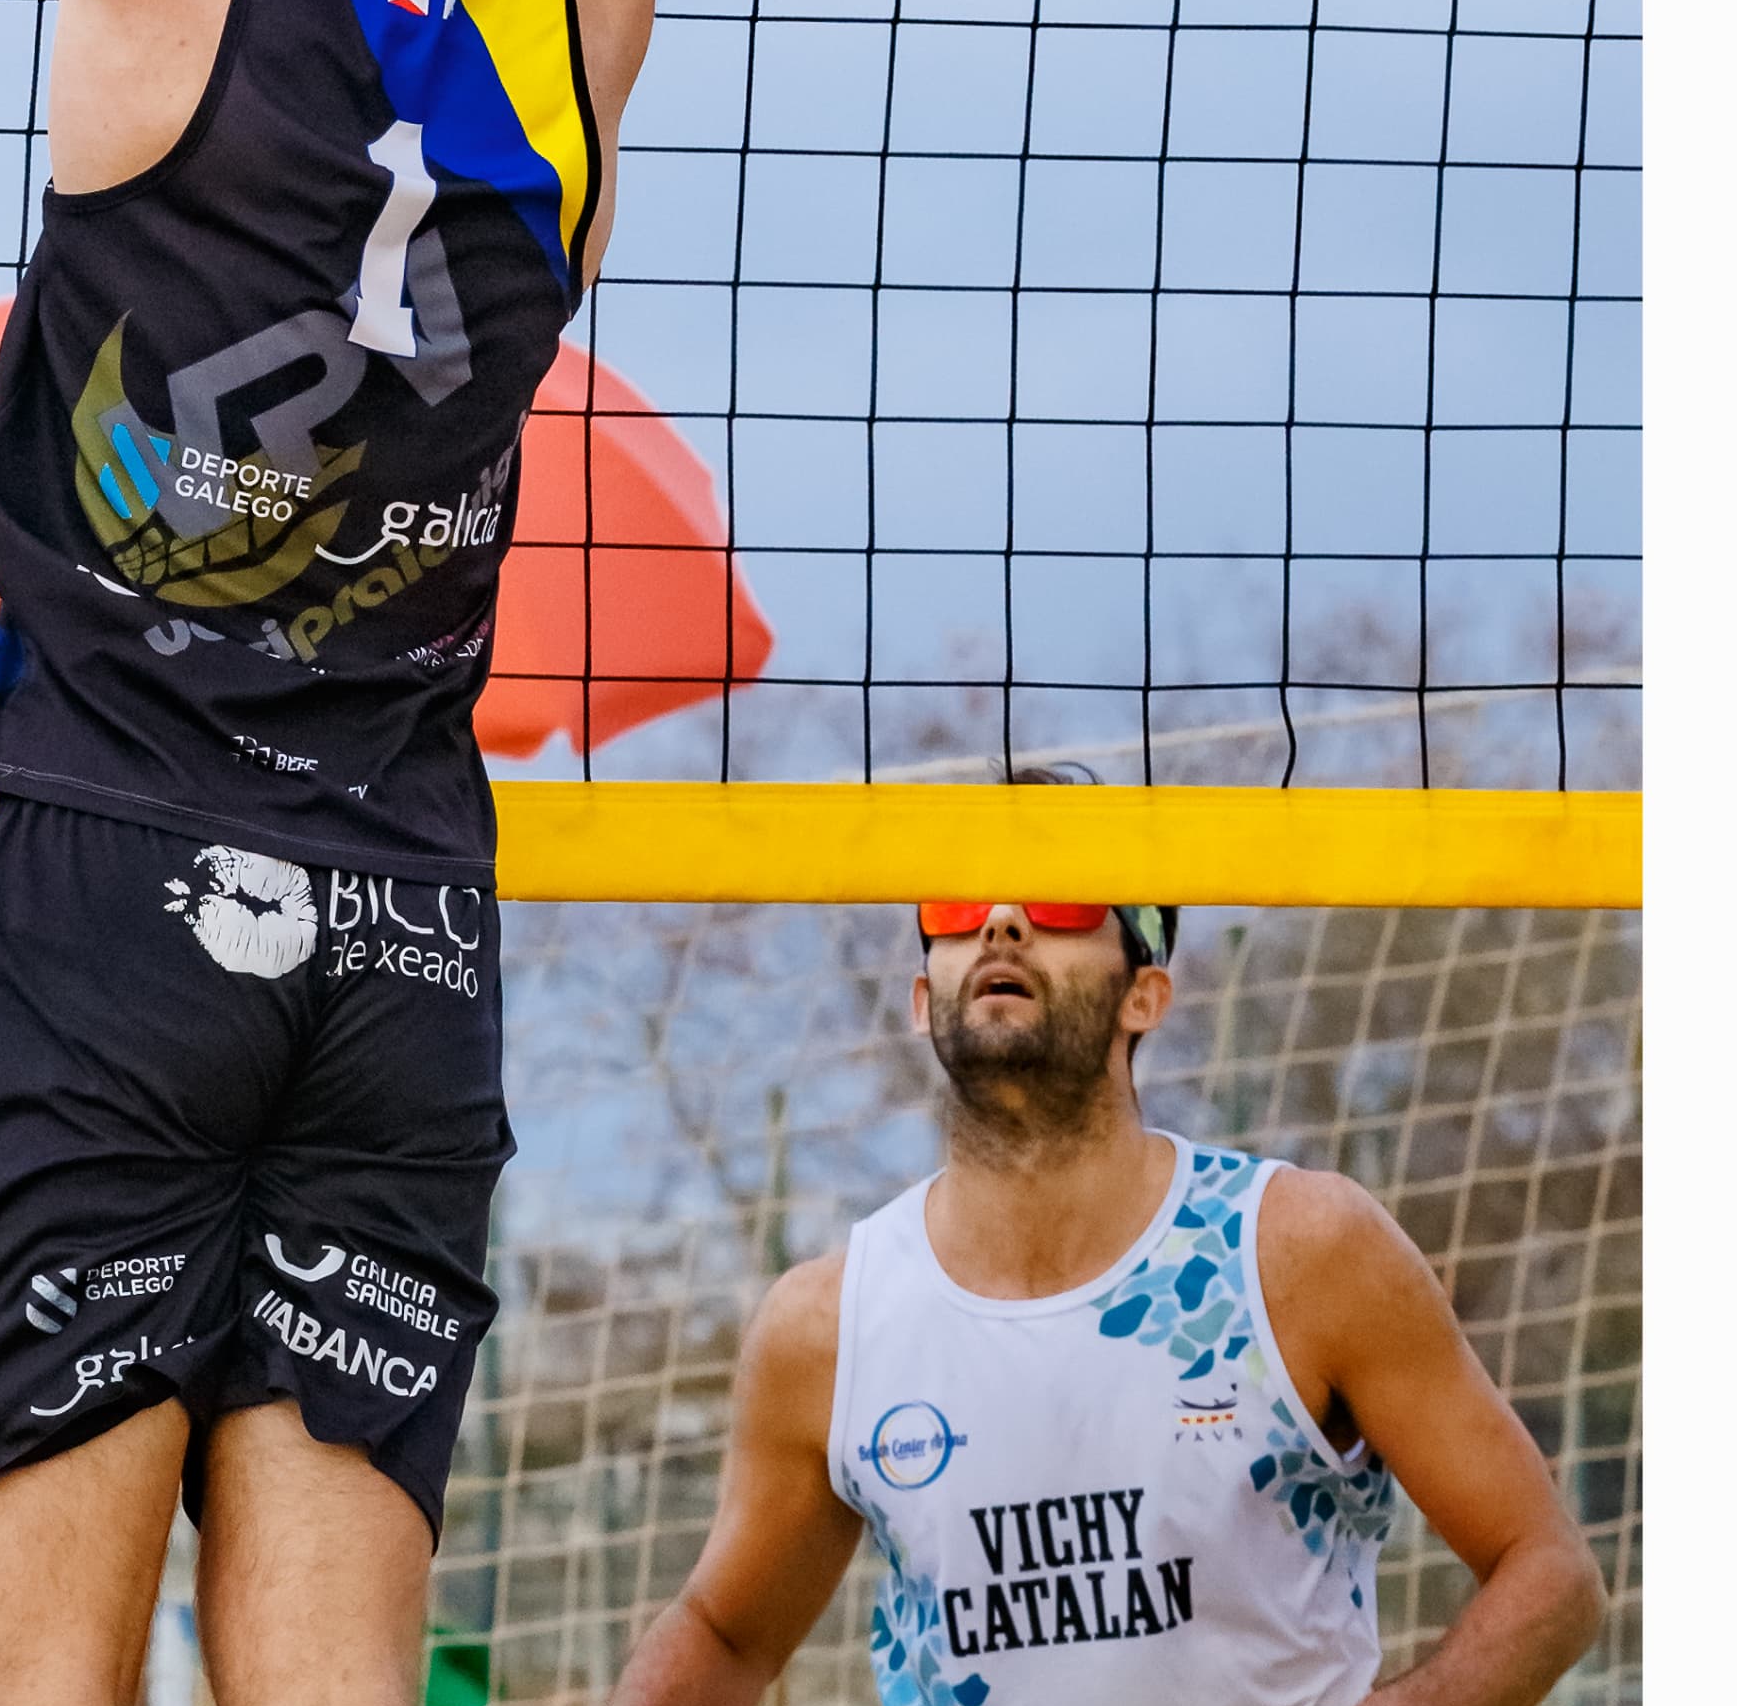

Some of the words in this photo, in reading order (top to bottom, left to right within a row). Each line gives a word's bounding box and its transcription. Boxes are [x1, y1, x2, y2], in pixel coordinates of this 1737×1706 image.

[347, 119, 437, 358] 1
[175, 474, 293, 522] GALEGO
[181, 447, 312, 499] DEPORTE
[315, 492, 501, 564] galicia
[375, 940, 479, 998] xeado
[85, 1275, 174, 1301] GALEGO
[86, 1254, 186, 1281] DEPORTE
[350, 1254, 437, 1307] GALICIA
[344, 1278, 460, 1341] SAUDABLE
[969, 1488, 1144, 1576] VICHY
[943, 1557, 1194, 1658] CATALAN
